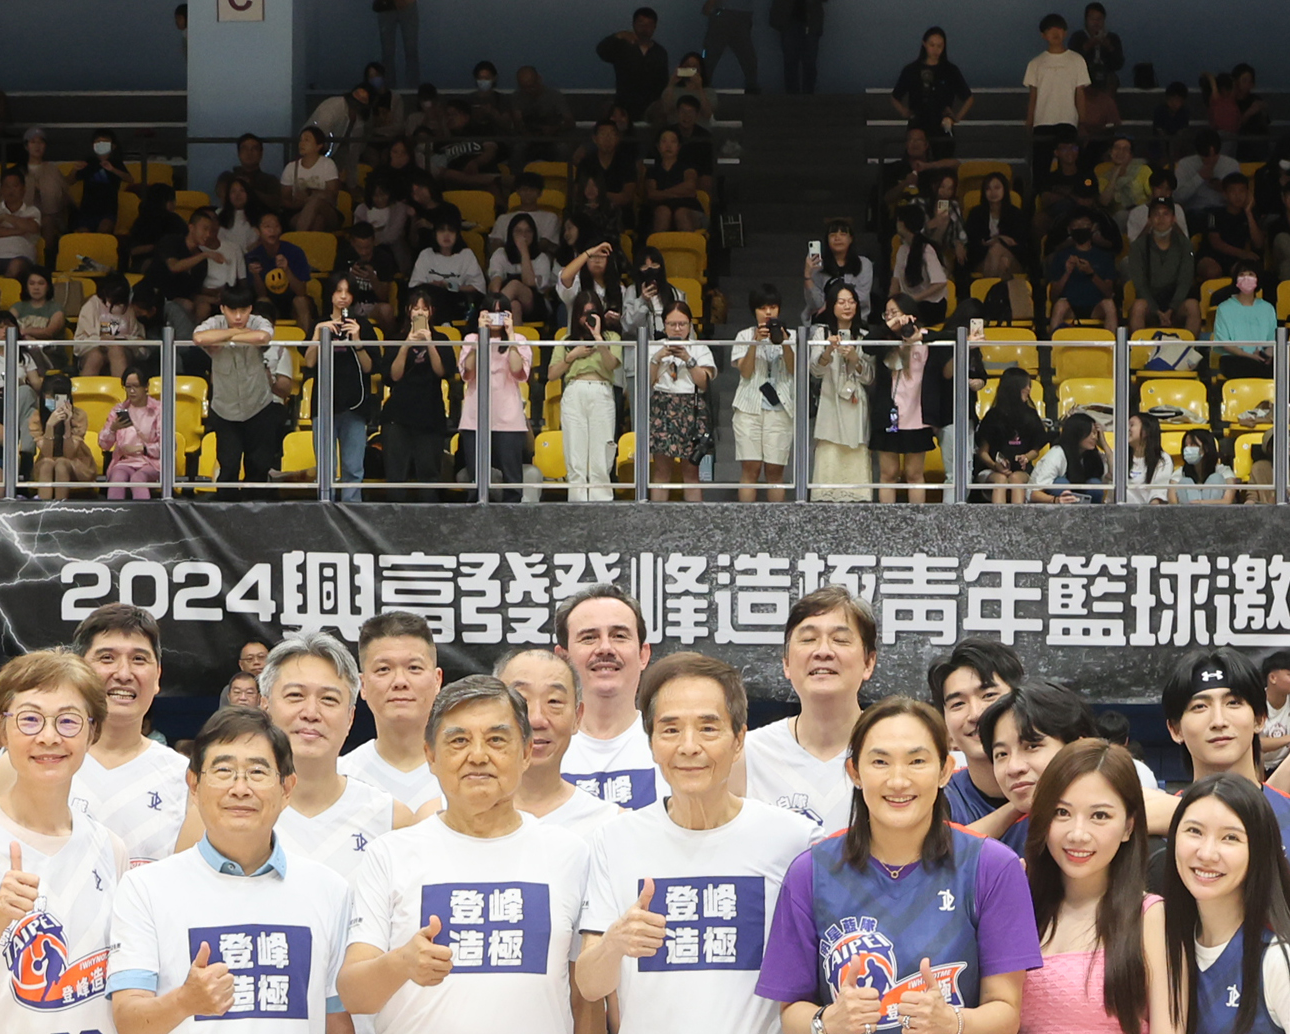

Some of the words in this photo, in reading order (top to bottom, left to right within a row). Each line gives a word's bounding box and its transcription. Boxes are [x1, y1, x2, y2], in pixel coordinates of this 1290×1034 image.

[449, 887, 525, 925] 登峰
[665, 883, 738, 922] 登峰
[2, 911, 64, 968] TAIPEI
[219, 931, 290, 970] 登峰
[448, 929, 525, 967] 造極
[665, 926, 738, 965] 造極
[60, 966, 110, 1004] 登峰造
